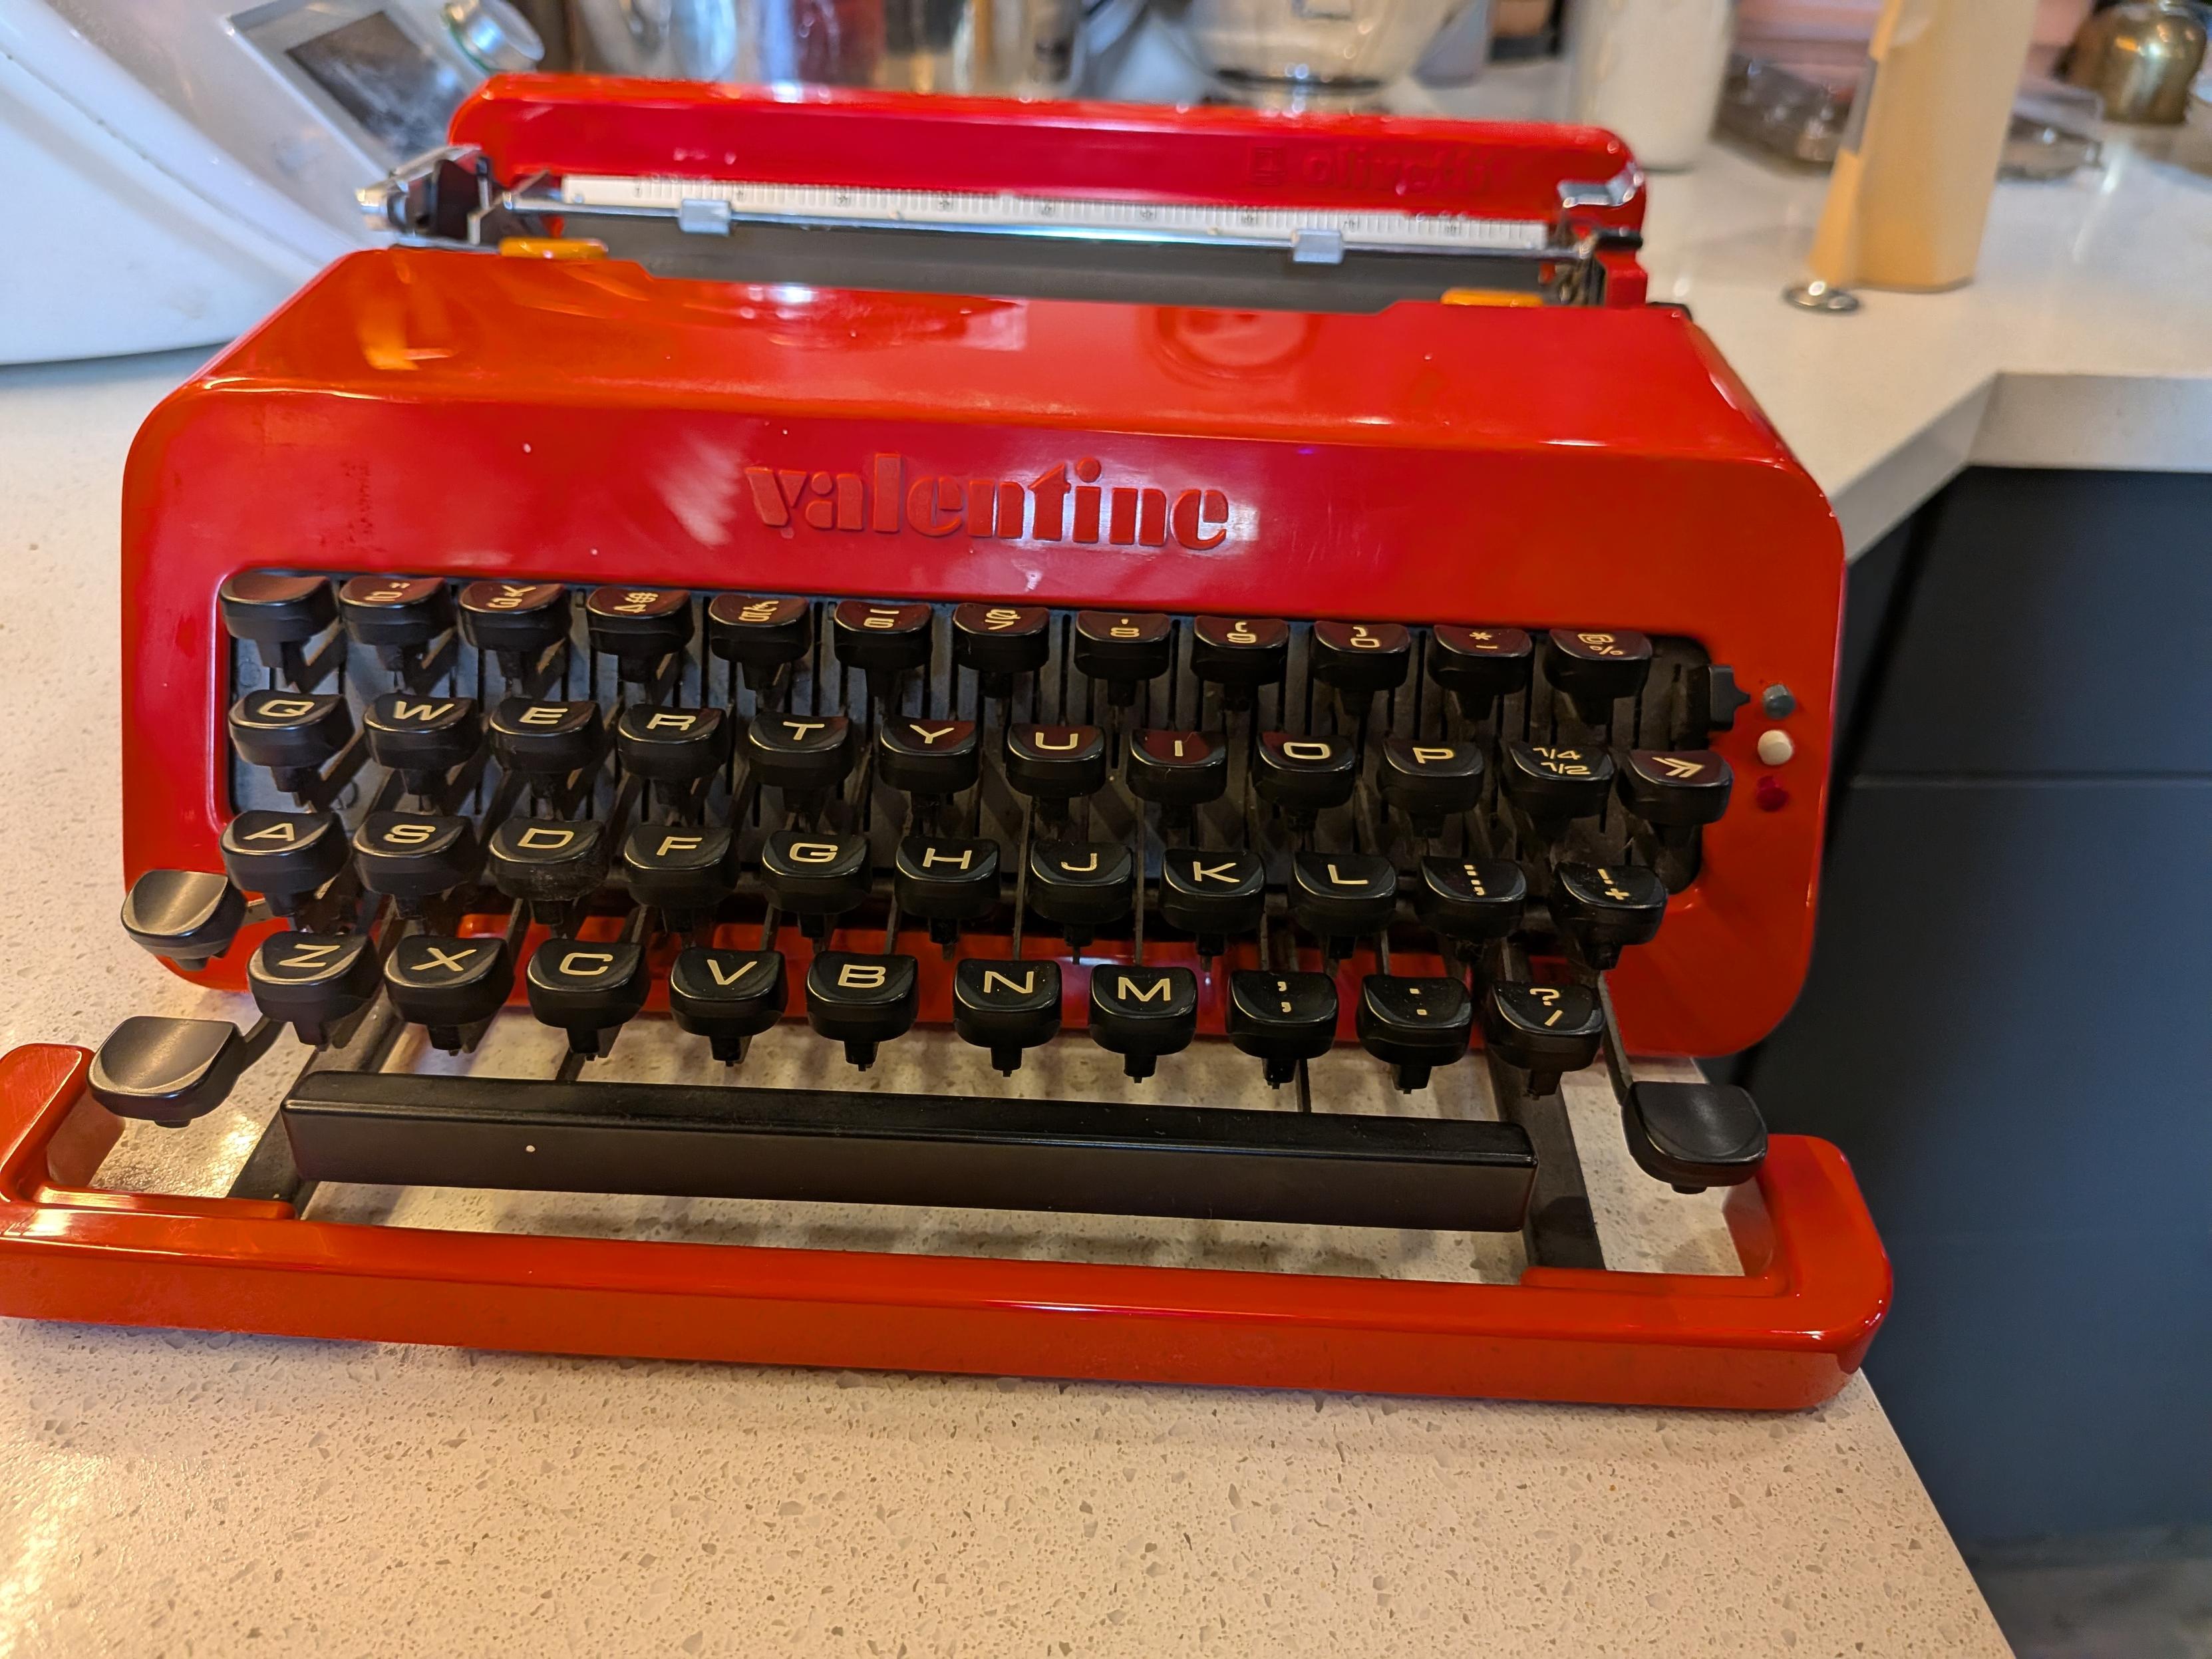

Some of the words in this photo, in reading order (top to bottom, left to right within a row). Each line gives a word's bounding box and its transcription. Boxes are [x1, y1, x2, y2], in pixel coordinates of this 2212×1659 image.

[744, 453, 1229, 549] valentine
[363, 590, 404, 603] 2
[485, 596, 524, 609] 3
[612, 603, 647, 615] 4
[737, 610, 773, 623] 5
[862, 617, 897, 629] 6
[984, 617, 1016, 631] 7
[1109, 626, 1141, 639] 8
[1225, 631, 1258, 645] 9
[257, 698, 315, 718] Q
[393, 699, 455, 722] W
[518, 706, 569, 725] E
[645, 712, 697, 732] R
[782, 720, 826, 741] T
[908, 723, 956, 744] Y
[1034, 731, 1079, 751] U
[1412, 746, 1456, 765] P
[242, 822, 296, 843] A
[383, 824, 437, 845] S
[517, 827, 575, 850] D
[655, 835, 704, 857] F
[788, 841, 840, 864] G
[921, 847, 973, 871] H
[1060, 851, 1098, 873] J
[1192, 860, 1241, 884] K
[1327, 863, 1370, 886] L
[277, 942, 342, 969] Z
[409, 946, 478, 973] X
[558, 951, 615, 977] C
[705, 958, 758, 986] V
[836, 963, 887, 990] B
[983, 969, 1035, 995] N
[1117, 975, 1172, 1003] M
